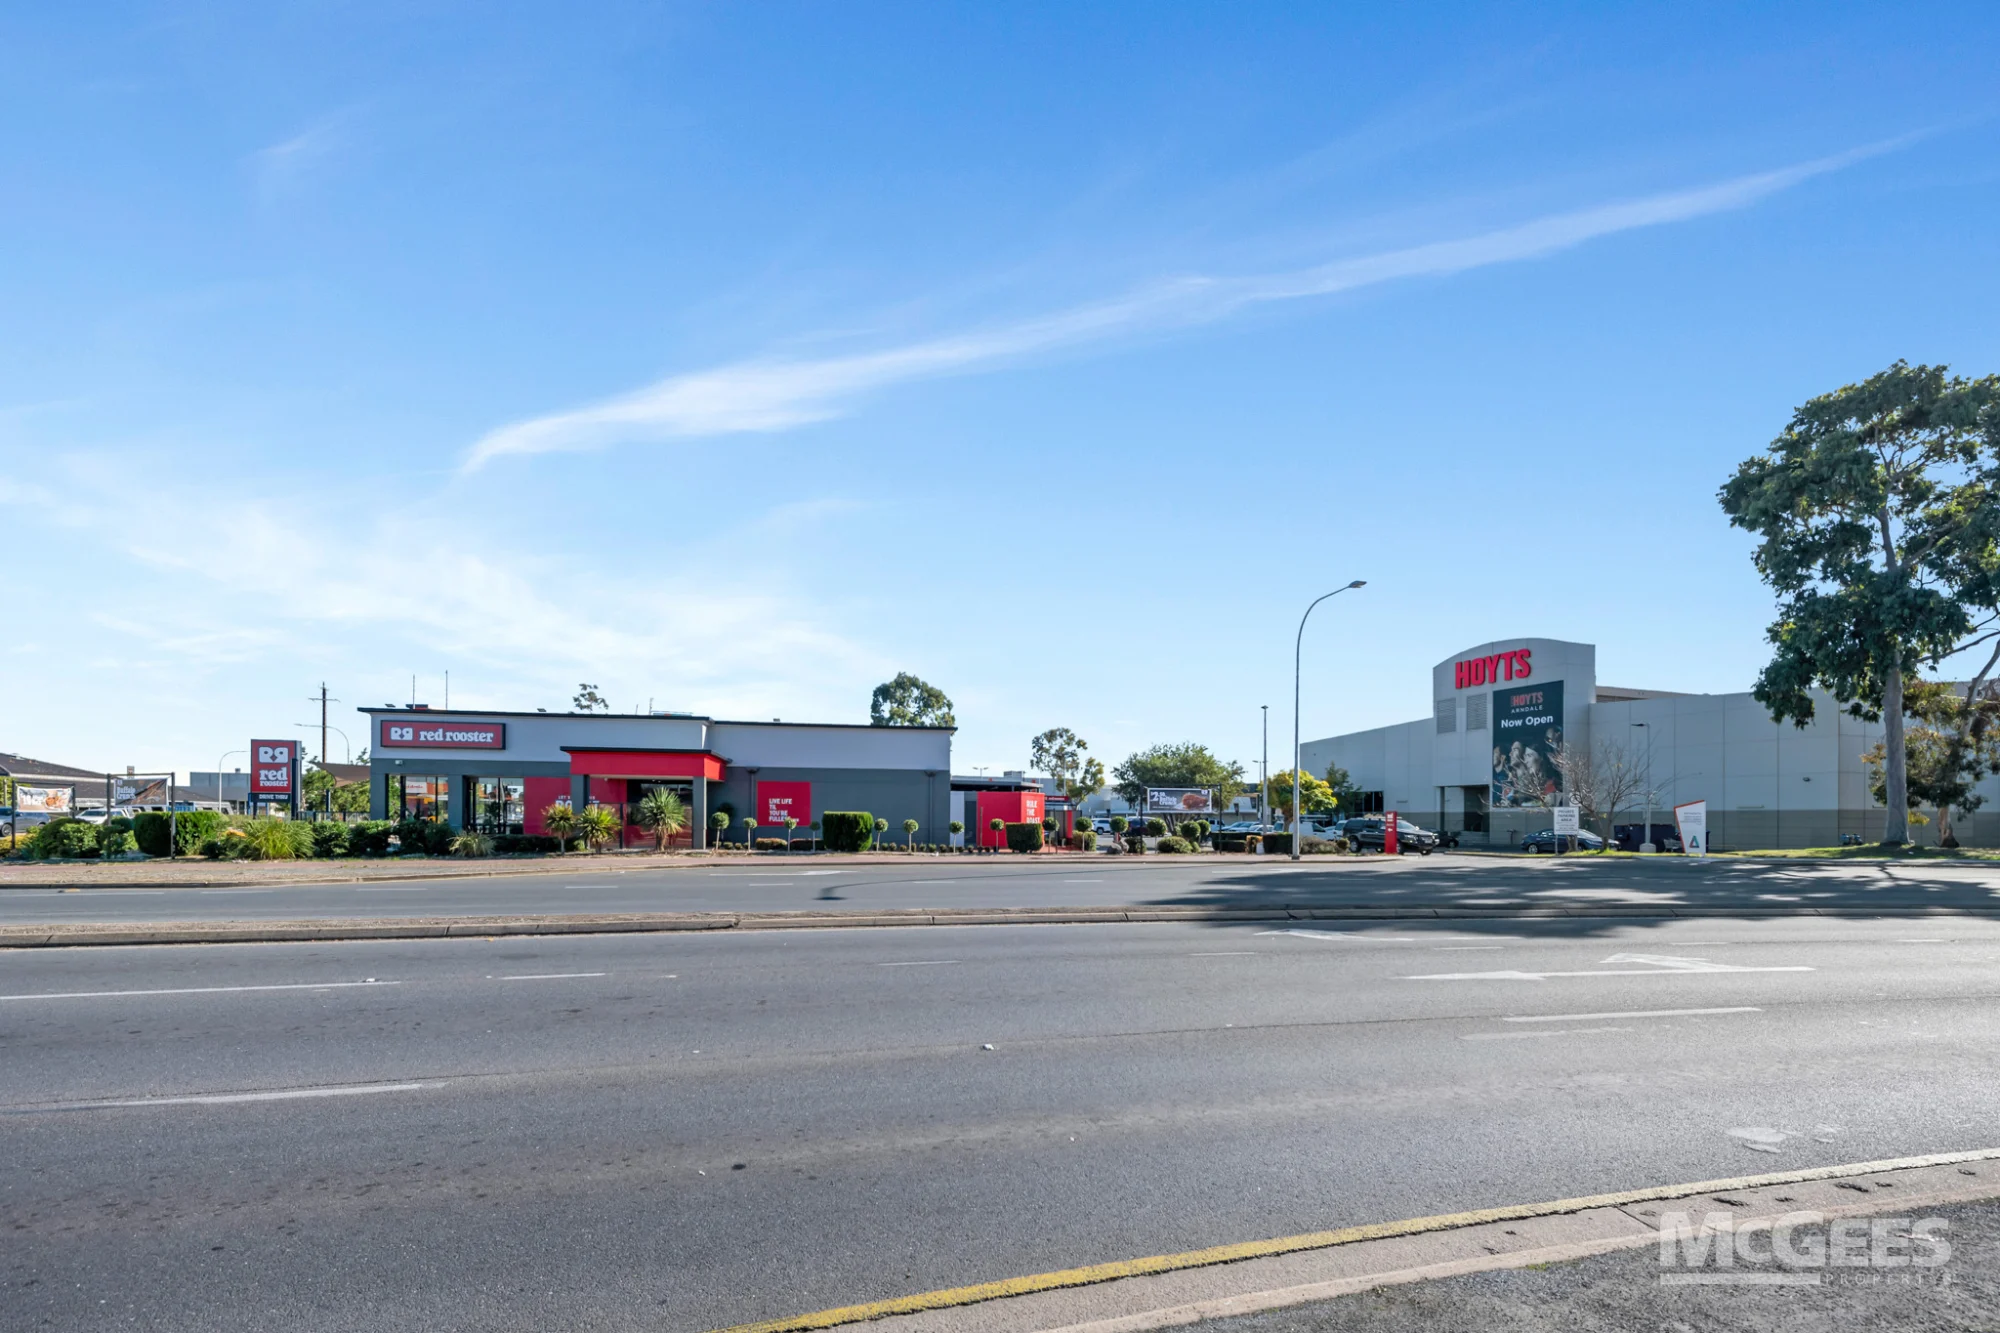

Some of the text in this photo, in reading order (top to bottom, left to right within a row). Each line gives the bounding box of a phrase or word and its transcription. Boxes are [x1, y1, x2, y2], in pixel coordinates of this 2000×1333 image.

[1455, 648, 1531, 689] HOYTS
[1512, 692, 1544, 706] HOYTS
[1511, 705, 1543, 714] ARNDALE
[1501, 716, 1553, 728] Now Open
[419, 728, 443, 741] red
[445, 731, 494, 743] rooster
[259, 767, 288, 780] red
[1026, 800, 1038, 808] RULE
[1026, 808, 1035, 816] THE
